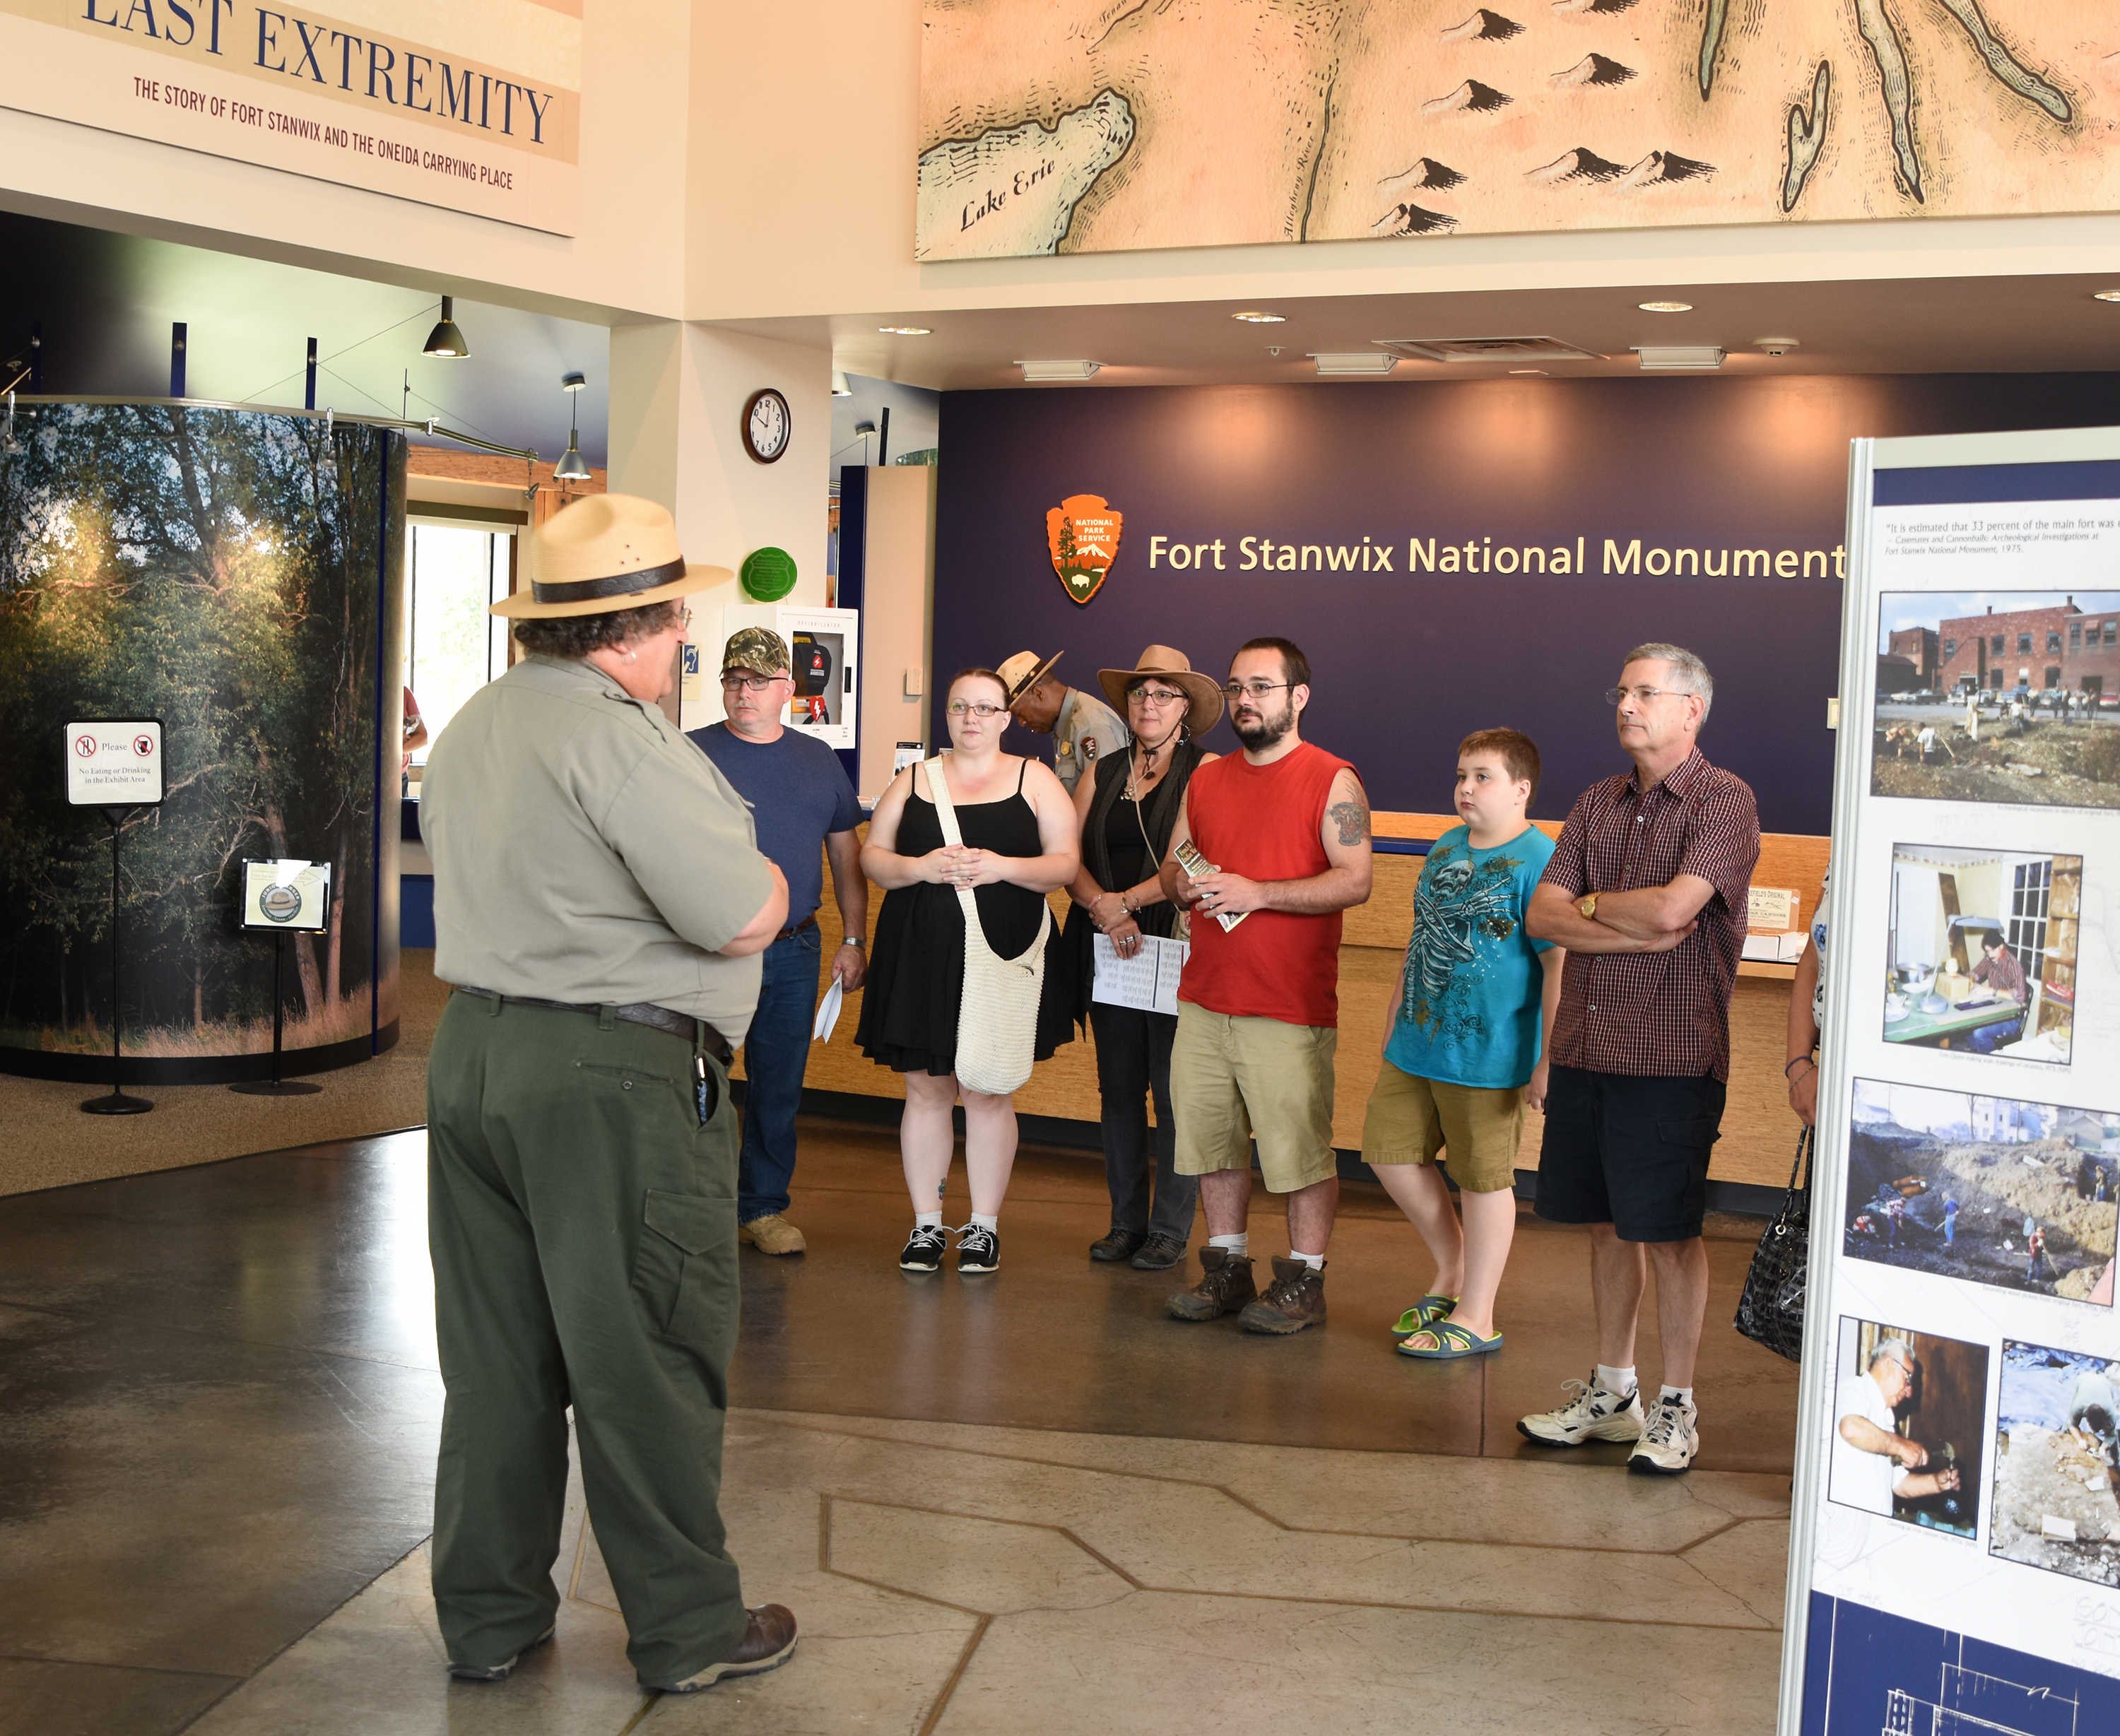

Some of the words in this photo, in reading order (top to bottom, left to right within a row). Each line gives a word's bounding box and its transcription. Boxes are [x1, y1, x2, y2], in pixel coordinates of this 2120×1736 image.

[254, 8, 553, 143] EXTREMITY
[134, 76, 160, 102] THE
[165, 84, 206, 113] STORY
[211, 96, 227, 117] OF
[232, 102, 264, 127] FORT
[268, 111, 321, 141] STANWIX
[324, 126, 348, 148] AND
[353, 132, 374, 155] THE
[378, 139, 419, 167] ONEIDA
[423, 150, 476, 181] CARRYING
[481, 165, 513, 190] PLACE
[1296, 135, 1314, 172] River
[960, 189, 1007, 233] Lake
[1013, 158, 1055, 196] Erie
[1895, 536, 1929, 544] Casemates
[1931, 535, 1944, 543] and
[1945, 534, 1988, 543] Cannonballs:
[1991, 533, 2039, 543] Archeological
[2042, 532, 2090, 542] Investigations
[1900, 523, 1906, 533] is
[1908, 522, 1948, 533] estimated
[1951, 521, 1967, 532] that
[1972, 520, 1984, 531] 33
[1986, 521, 2020, 533] percent
[2022, 519, 2033, 530] of
[2035, 519, 2049, 530] the
[2052, 519, 2074, 529] main
[2078, 519, 2095, 529] fort
[2098, 520, 2114, 529] was
[1149, 536, 1226, 571] Fort
[1238, 536, 1394, 573] Stanwix
[1408, 536, 1584, 575] National
[1601, 539, 1846, 579] Monument
[1885, 547, 1899, 555] Fort
[1928, 545, 1956, 555] National
[1958, 545, 1998, 555] Monument,
[2001, 545, 2023, 553] 1975.
[122, 767, 151, 775] Drinking
[262, 884, 276, 898] JUNIO
